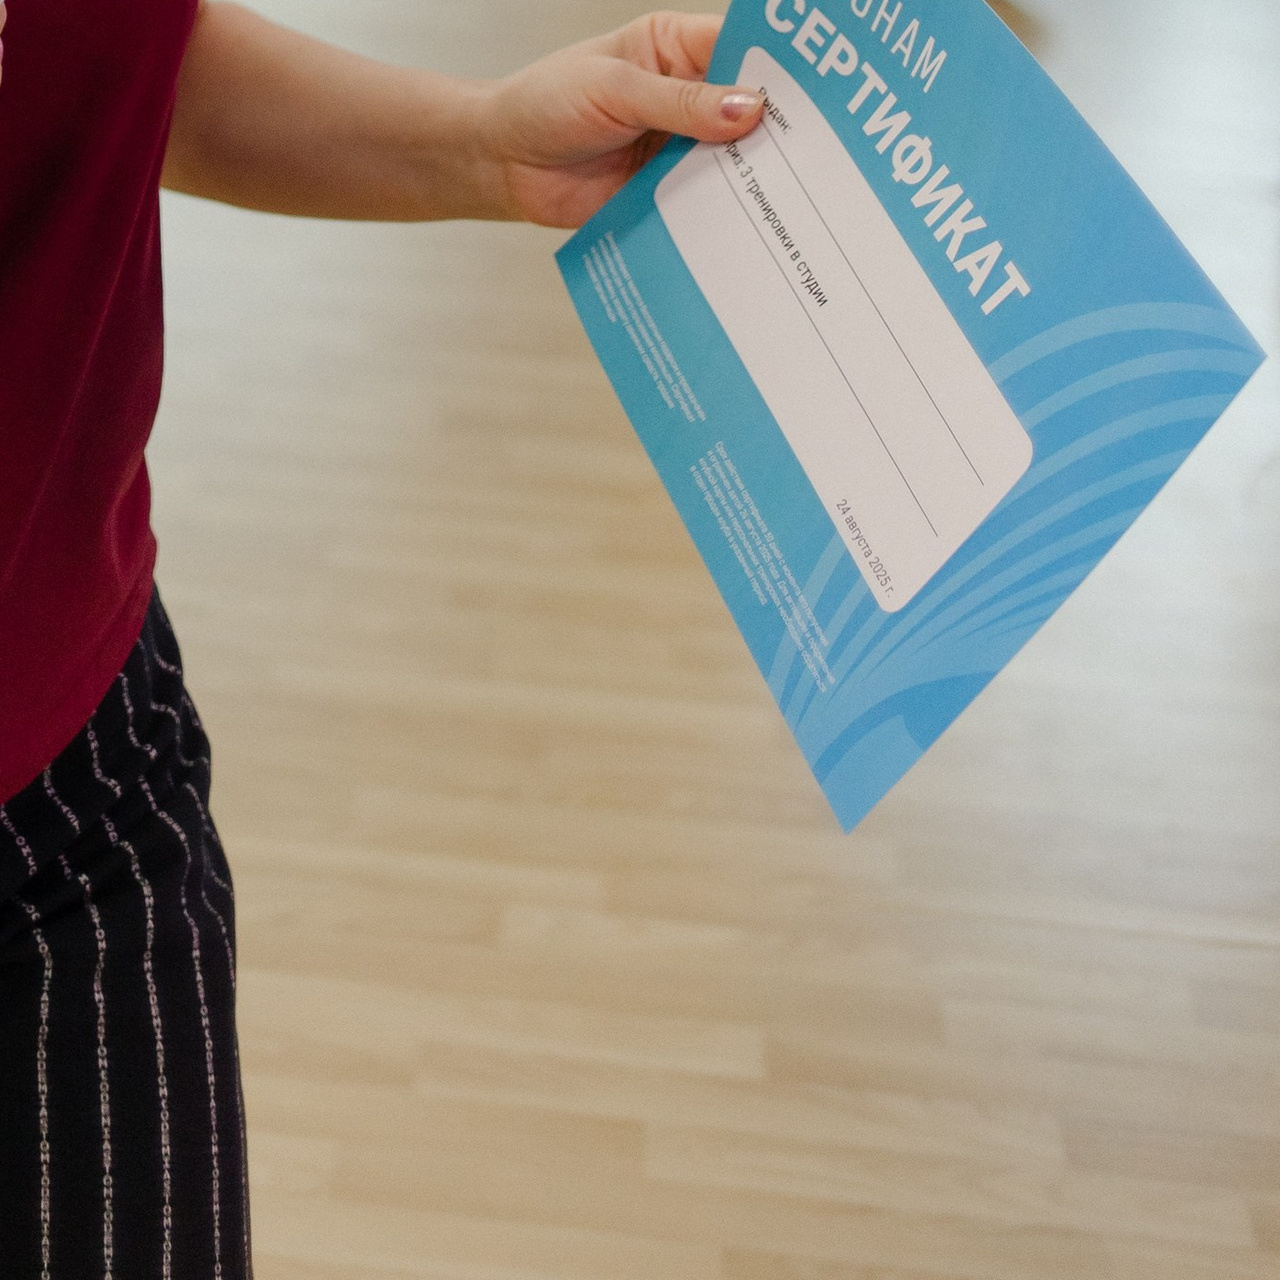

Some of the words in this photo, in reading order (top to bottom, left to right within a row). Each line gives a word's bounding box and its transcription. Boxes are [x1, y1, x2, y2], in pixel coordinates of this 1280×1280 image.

[740, 166, 753, 178] 3
[746, 177, 796, 251] тренировки
[789, 250, 801, 262] в
[796, 260, 829, 308] студии
[757, 543, 772, 563] 2025
[836, 498, 852, 516] 24
[844, 515, 873, 559] августа
[868, 556, 892, 588] 2025
[884, 585, 895, 598] г.
